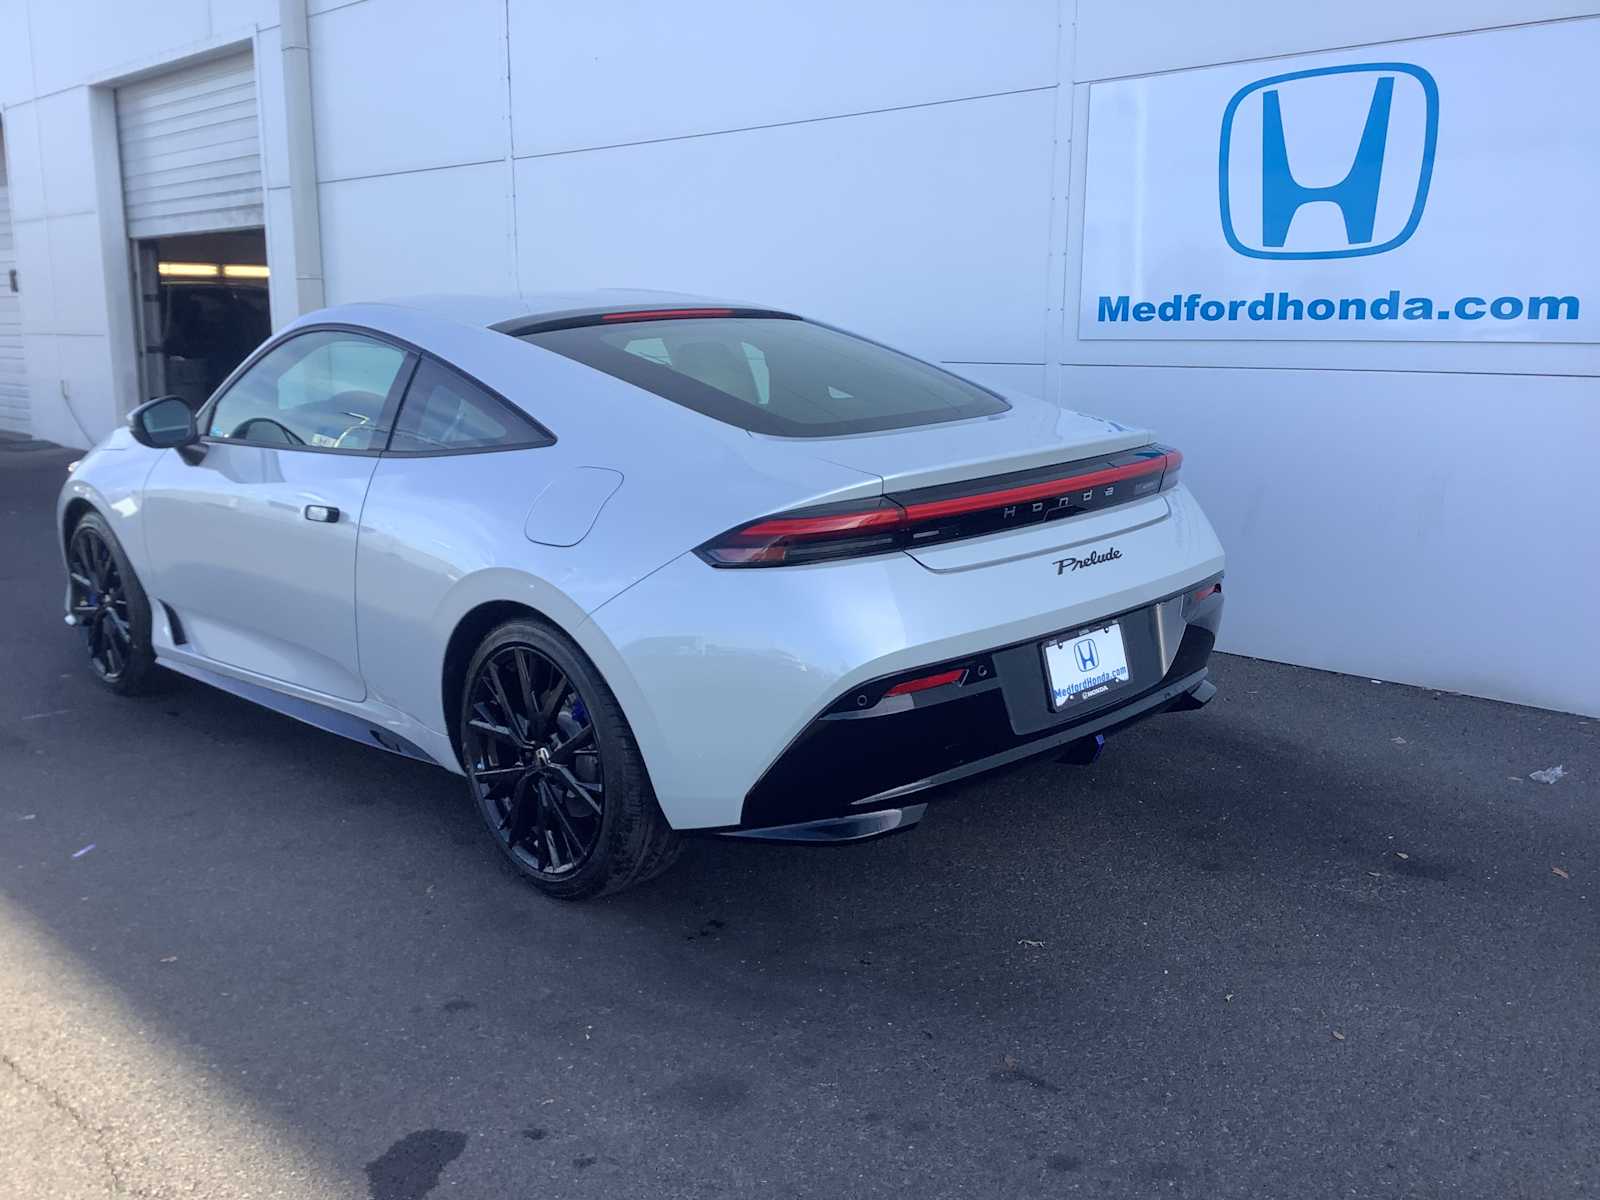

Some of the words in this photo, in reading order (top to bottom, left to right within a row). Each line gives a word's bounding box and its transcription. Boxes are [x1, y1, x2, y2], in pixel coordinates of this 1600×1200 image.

[1097, 291, 1580, 322] Medfordhonda.com
[1052, 547, 1123, 575] Prelude
[1053, 666, 1127, 699] MedfordHonda.com
[1087, 685, 1109, 697] HONDA
